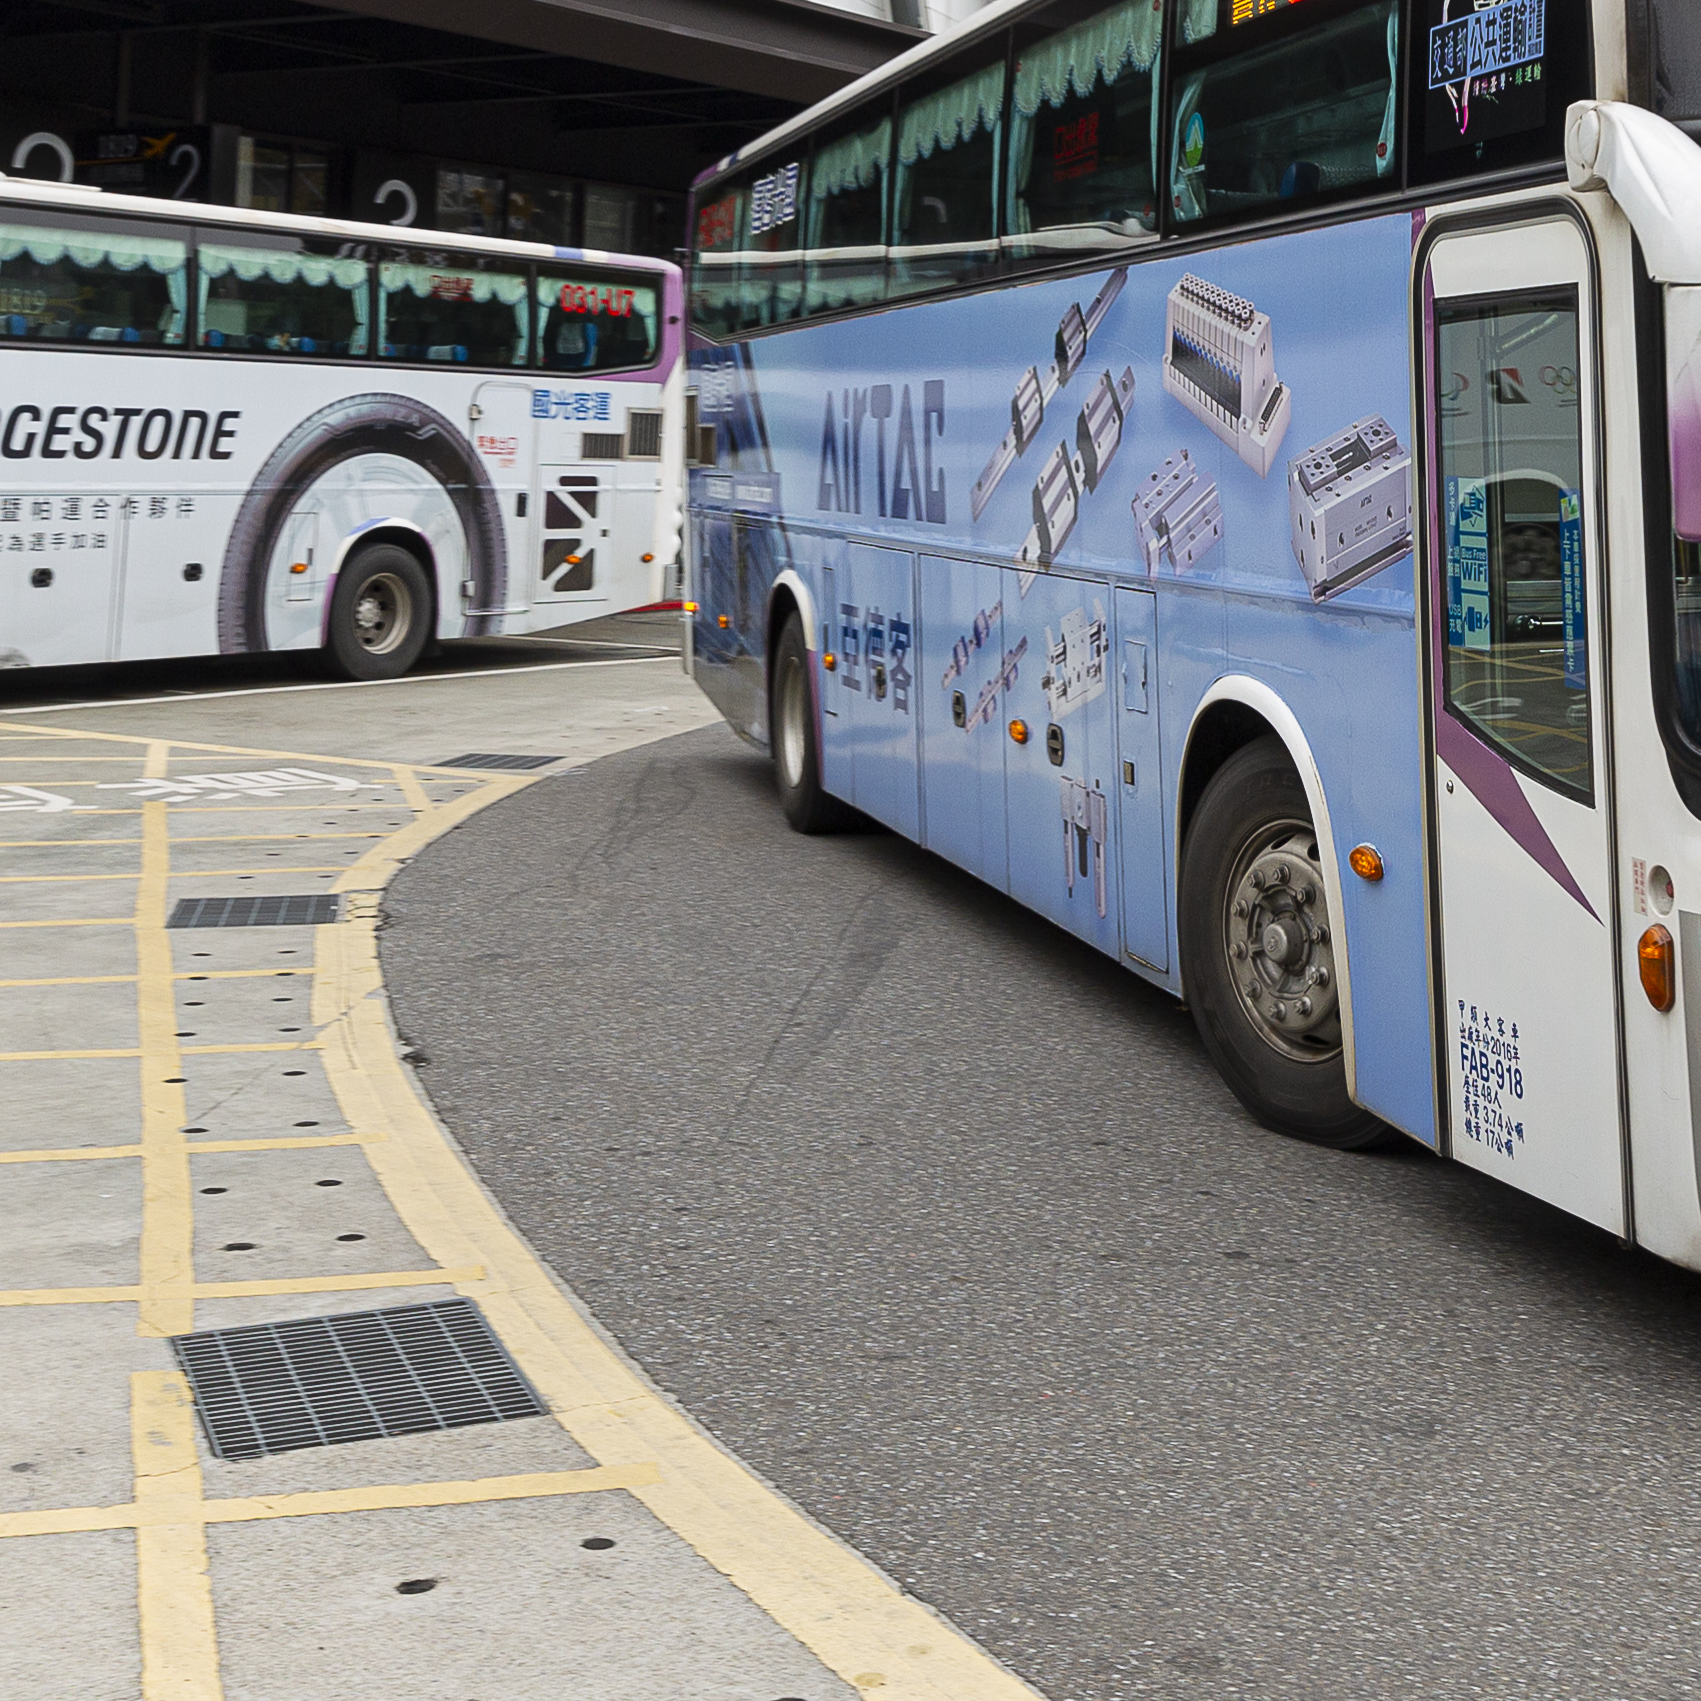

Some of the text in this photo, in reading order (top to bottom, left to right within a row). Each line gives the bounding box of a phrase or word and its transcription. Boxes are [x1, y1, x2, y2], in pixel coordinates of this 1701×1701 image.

[560, 283, 636, 318] 031-U7
[532, 389, 611, 421] 國光客運
[1461, 561, 1487, 583] WiFi
[1460, 1041, 1524, 1100] FAB-918
[1483, 1105, 1504, 1133] 3.74
